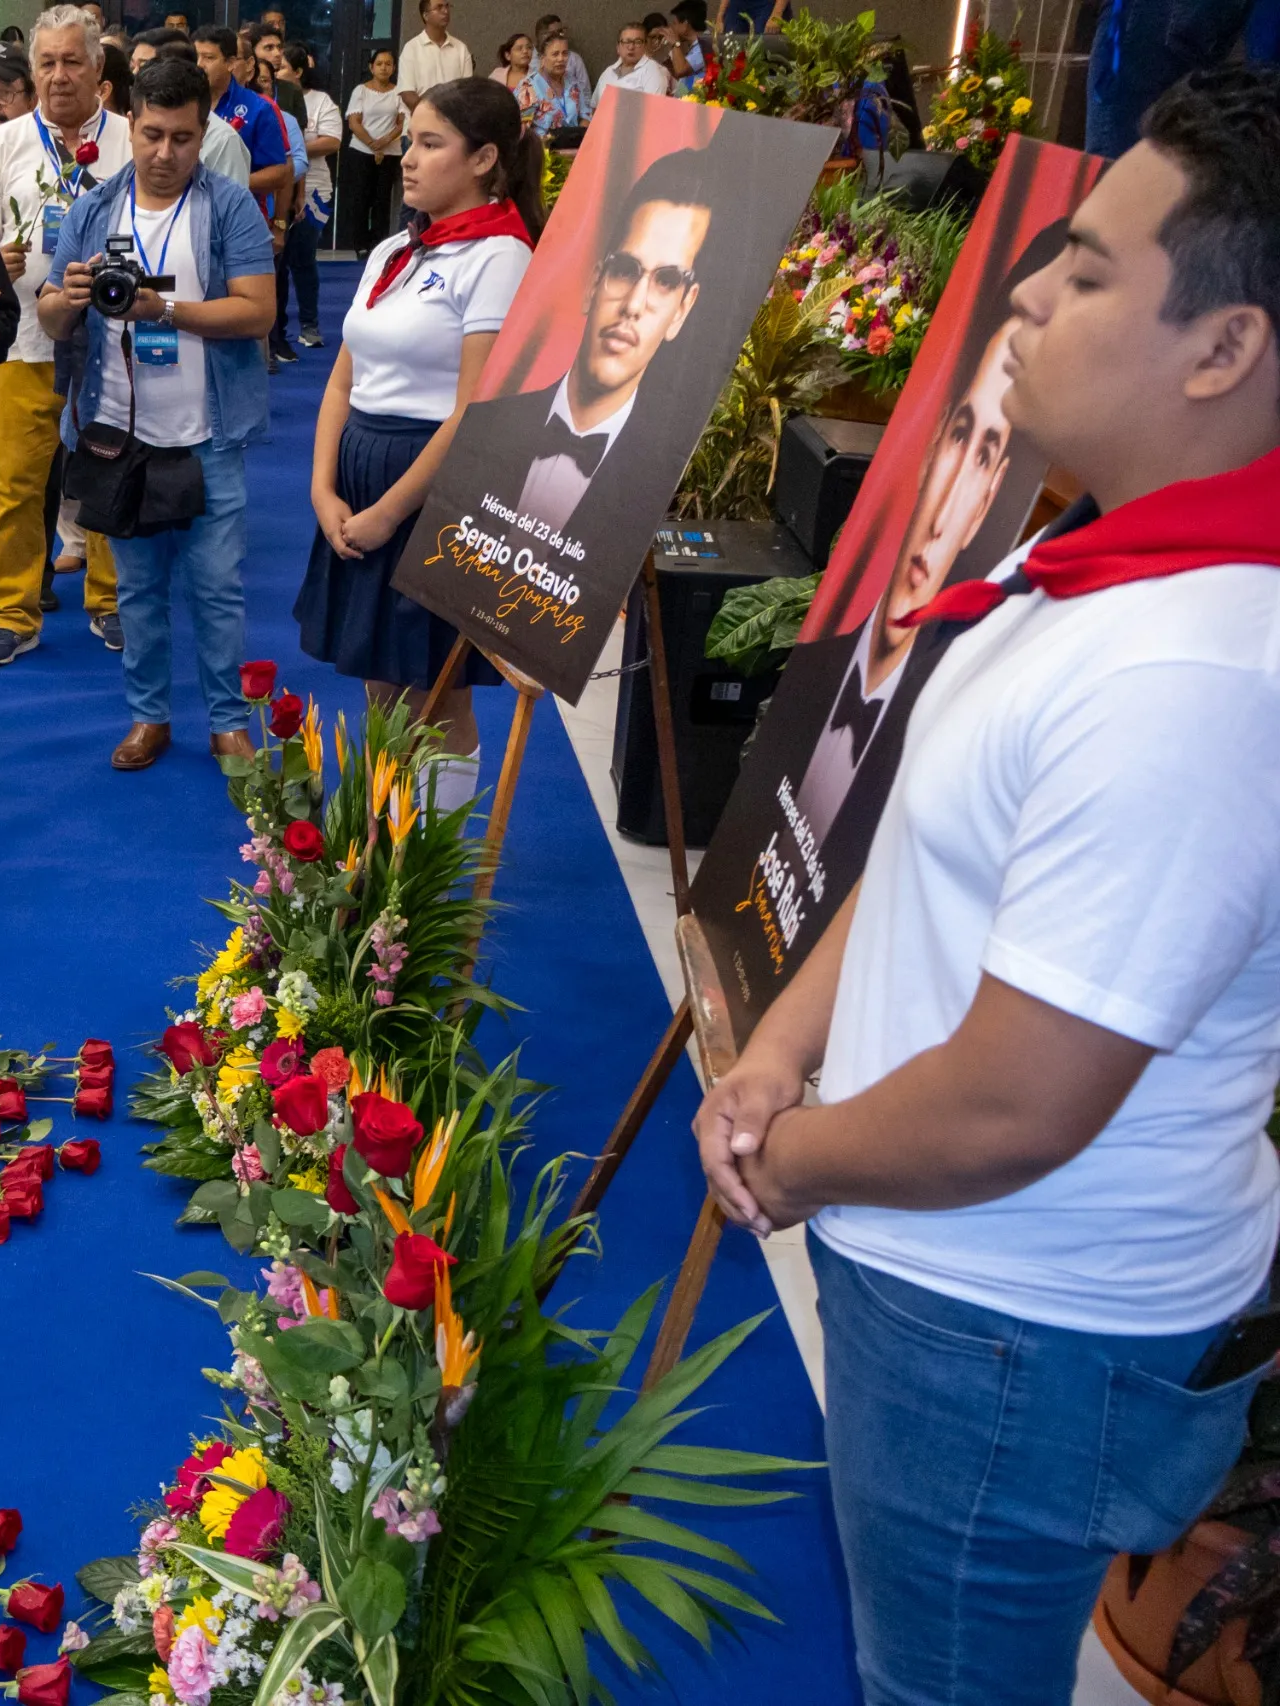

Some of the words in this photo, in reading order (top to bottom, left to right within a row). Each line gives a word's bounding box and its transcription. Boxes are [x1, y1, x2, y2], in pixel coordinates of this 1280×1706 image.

[481, 493, 518, 524] Héroes
[517, 513, 536, 533] del
[534, 522, 550, 541] 23
[549, 530, 563, 549] de
[560, 536, 586, 561] julio
[424, 524, 504, 582] Saldaña
[496, 572, 586, 644] González
[454, 515, 512, 565] Sergio
[513, 547, 580, 606] Octavio
[476, 609, 510, 635] 23-07-1959
[777, 776, 798, 827] Héroes
[794, 815, 810, 846] del
[801, 832, 816, 862] 23
[806, 849, 819, 878] de
[759, 832, 790, 898] José
[776, 873, 806, 949] Rubí
